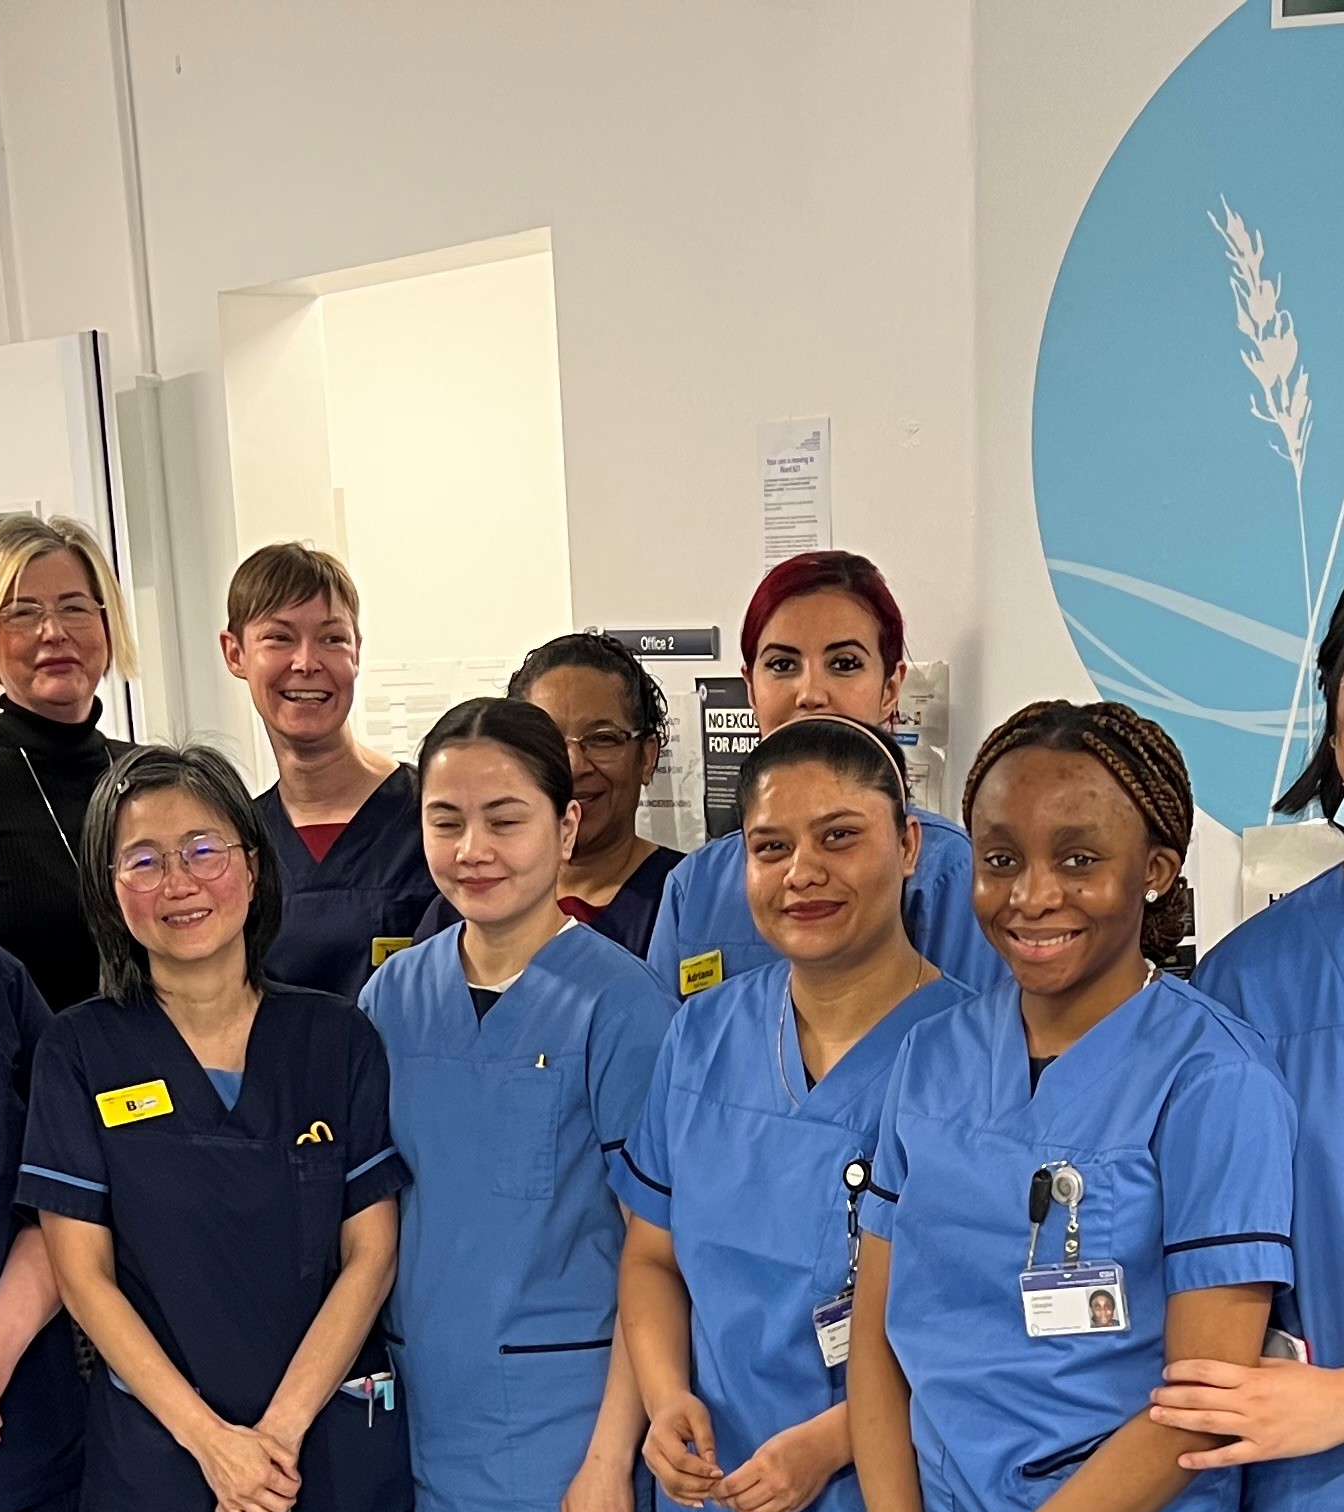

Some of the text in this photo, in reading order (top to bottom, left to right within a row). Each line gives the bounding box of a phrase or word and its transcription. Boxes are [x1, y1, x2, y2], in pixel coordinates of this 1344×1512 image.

[640, 636, 675, 651] Office 2
[708, 712, 760, 728] NO EXCUS
[708, 736, 760, 753] FOR ABUS
